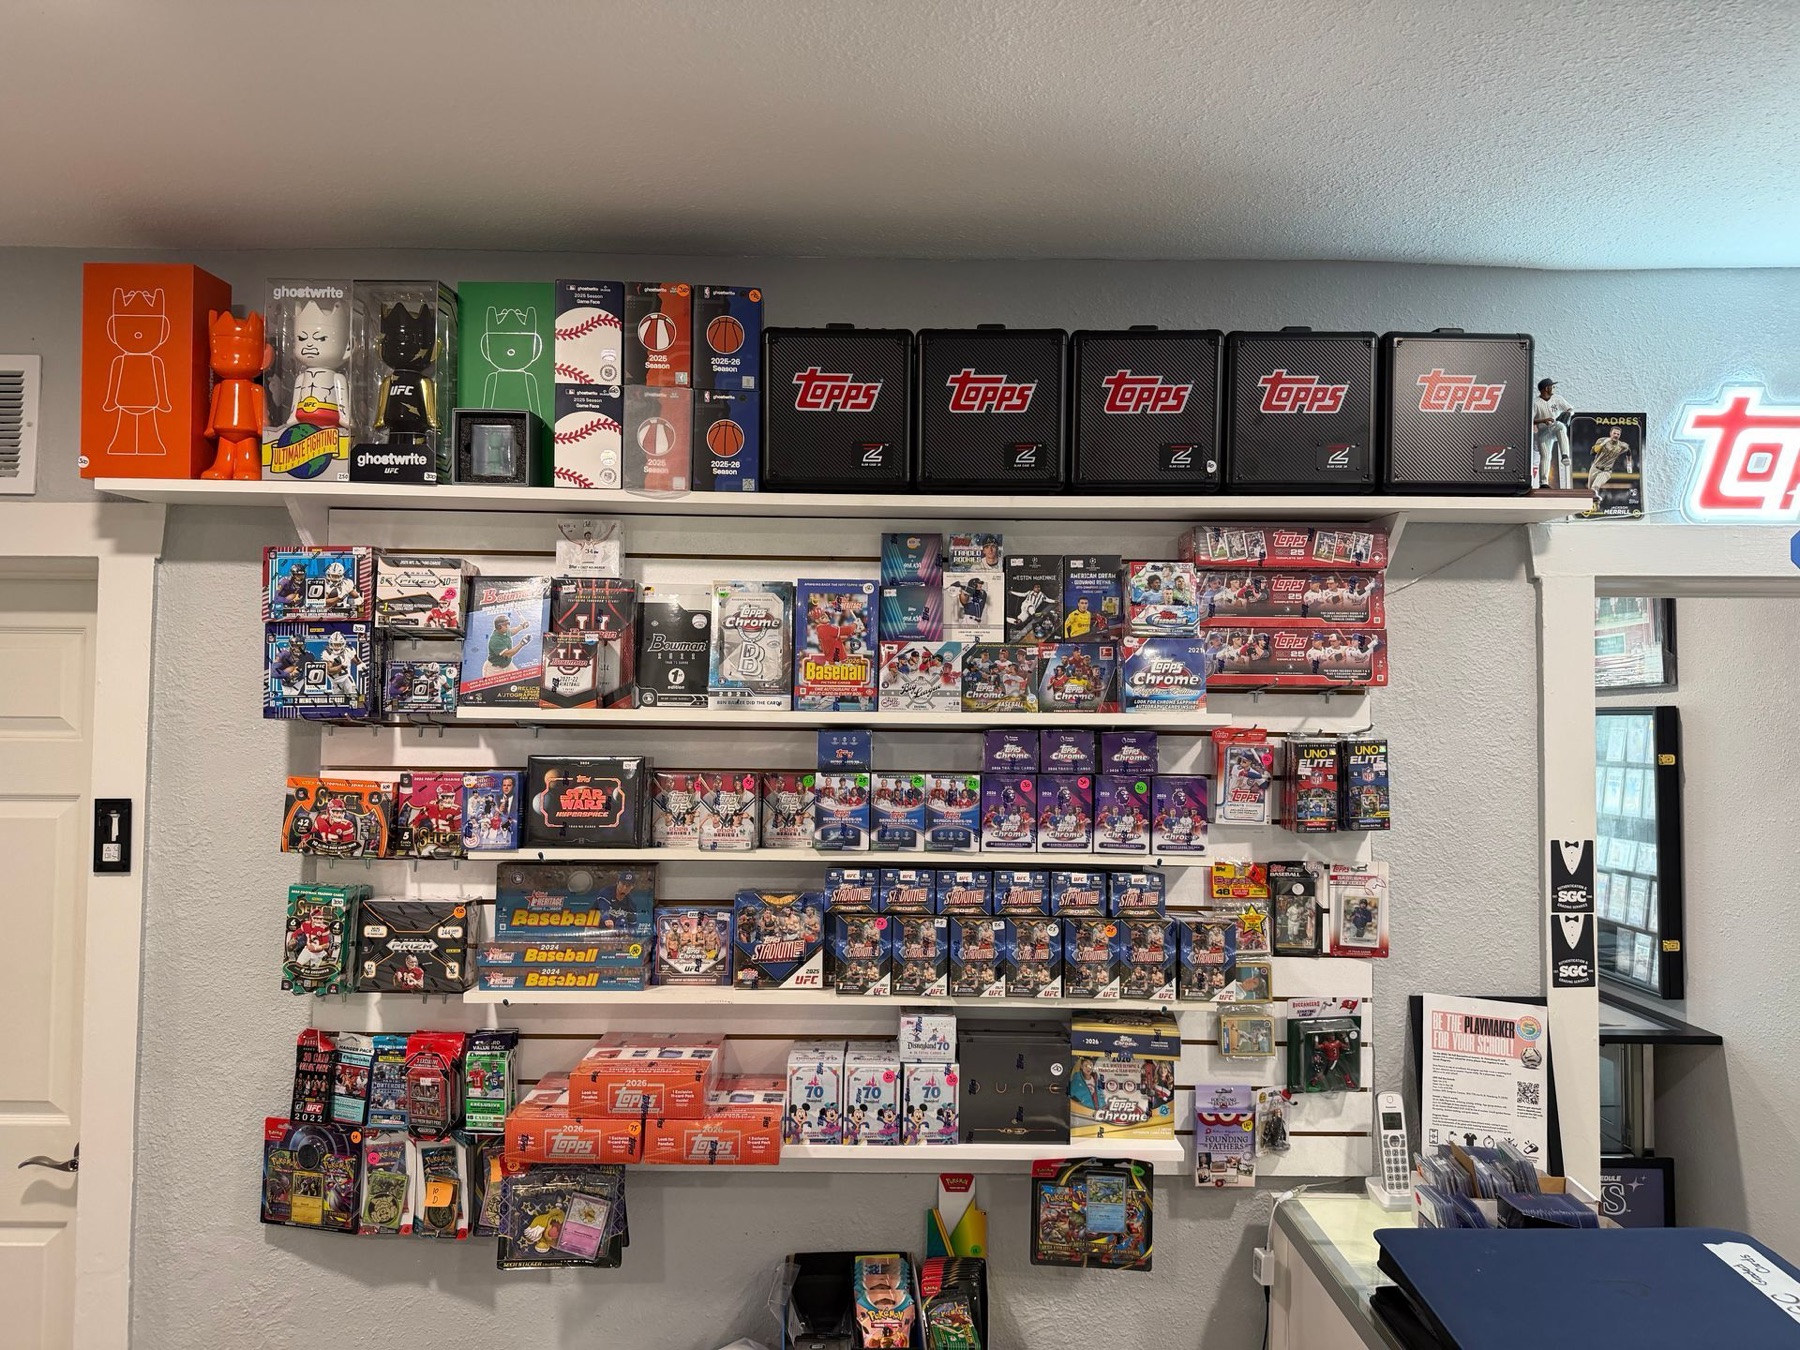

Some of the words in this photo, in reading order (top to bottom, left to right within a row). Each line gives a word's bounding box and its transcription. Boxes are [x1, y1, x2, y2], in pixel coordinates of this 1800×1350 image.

[273, 286, 344, 300] ghostwrite
[645, 362, 670, 370] Season
[711, 358, 741, 366] 2025-26
[713, 365, 738, 373] Season
[390, 385, 415, 397] UFC
[1596, 417, 1639, 426] PADRES
[274, 441, 306, 466] ULTIMATE
[307, 430, 339, 451] FIGHTING
[357, 453, 428, 467] ghostwrite
[648, 459, 667, 467] 2025
[710, 461, 741, 469] 2025-26
[644, 466, 670, 474] Season
[712, 468, 738, 476] Season
[725, 617, 780, 628] Chrome
[648, 634, 707, 652] Bowman
[806, 662, 867, 681] Baseball
[1134, 673, 1199, 686] Chrome
[901, 684, 918, 696] Big
[914, 686, 941, 699] League
[966, 690, 1004, 699] Chrome
[1304, 750, 1328, 759] UNO
[1355, 746, 1379, 755] UNO
[995, 752, 1029, 761] Chrome
[1051, 753, 1086, 761] Chrome
[1113, 754, 1148, 762] Chrome
[1350, 755, 1385, 765] ELITE
[1299, 759, 1334, 768] ELITE
[560, 789, 607, 800] STAR
[560, 800, 607, 810] WARS
[672, 804, 688, 813] 75
[719, 804, 735, 813] 75
[297, 819, 311, 827] 42
[403, 832, 410, 840] 5
[992, 830, 1028, 839] Chrome
[1048, 830, 1084, 839] Chrome
[831, 888, 864, 903] STADIUM
[944, 890, 977, 904] STADIUM
[1002, 891, 1035, 906] STADIUM
[1558, 890, 1587, 903] SGC
[511, 909, 601, 927] Baseball
[524, 949, 600, 963] Baseball
[753, 942, 797, 963] STADIUM
[1559, 965, 1588, 978] SGC
[525, 972, 600, 988] Baseball
[795, 975, 819, 985] UFC
[1292, 1001, 1321, 1010] BUCCANEERS
[1432, 1013, 1445, 1030] BE
[1446, 1014, 1463, 1033] THE
[1464, 1016, 1516, 1039] PLAYMAKER
[907, 1042, 937, 1050] Disneyland
[937, 1043, 950, 1051] 70
[1433, 1030, 1449, 1049] FOR
[1452, 1032, 1476, 1052] YOUR
[1477, 1036, 1515, 1057] SCHOOL!
[299, 1063, 315, 1072] VALUE
[315, 1065, 329, 1073] PACK
[804, 1086, 825, 1099] 70
[862, 1087, 882, 1099] 70
[922, 1086, 942, 1099] 70
[307, 1104, 322, 1113] UFC
[295, 1113, 323, 1123] 2022
[1095, 1111, 1148, 1121] Chrome
[563, 1125, 584, 1133] 2026
[702, 1126, 724, 1134] 2026
[1205, 1136, 1249, 1144] FOUNDING
[1740, 1254, 1771, 1274] Cards
